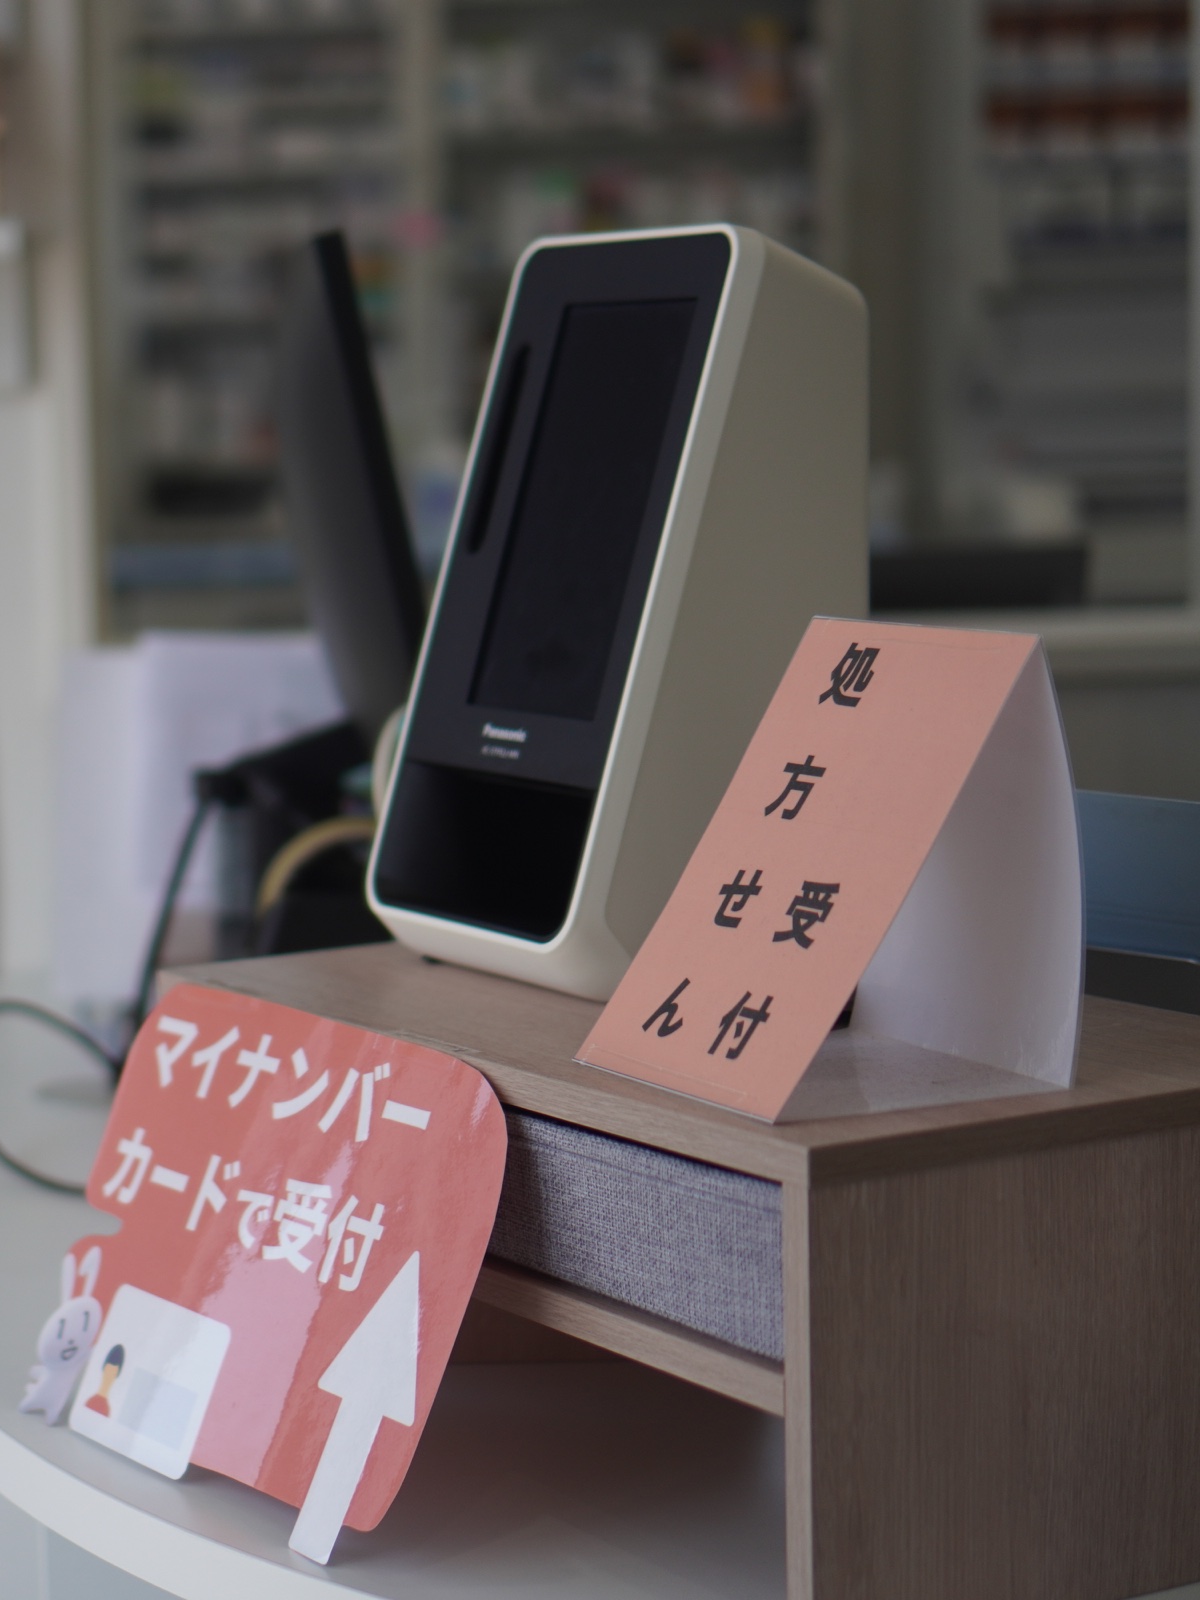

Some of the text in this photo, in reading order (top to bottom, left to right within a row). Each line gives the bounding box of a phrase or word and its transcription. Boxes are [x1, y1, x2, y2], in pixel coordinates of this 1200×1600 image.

[642, 642, 880, 1037] 処方せん
[707, 881, 840, 1060] 受付
[156, 1015, 431, 1142] マイナンバー
[103, 1127, 384, 1292] カードで受付
